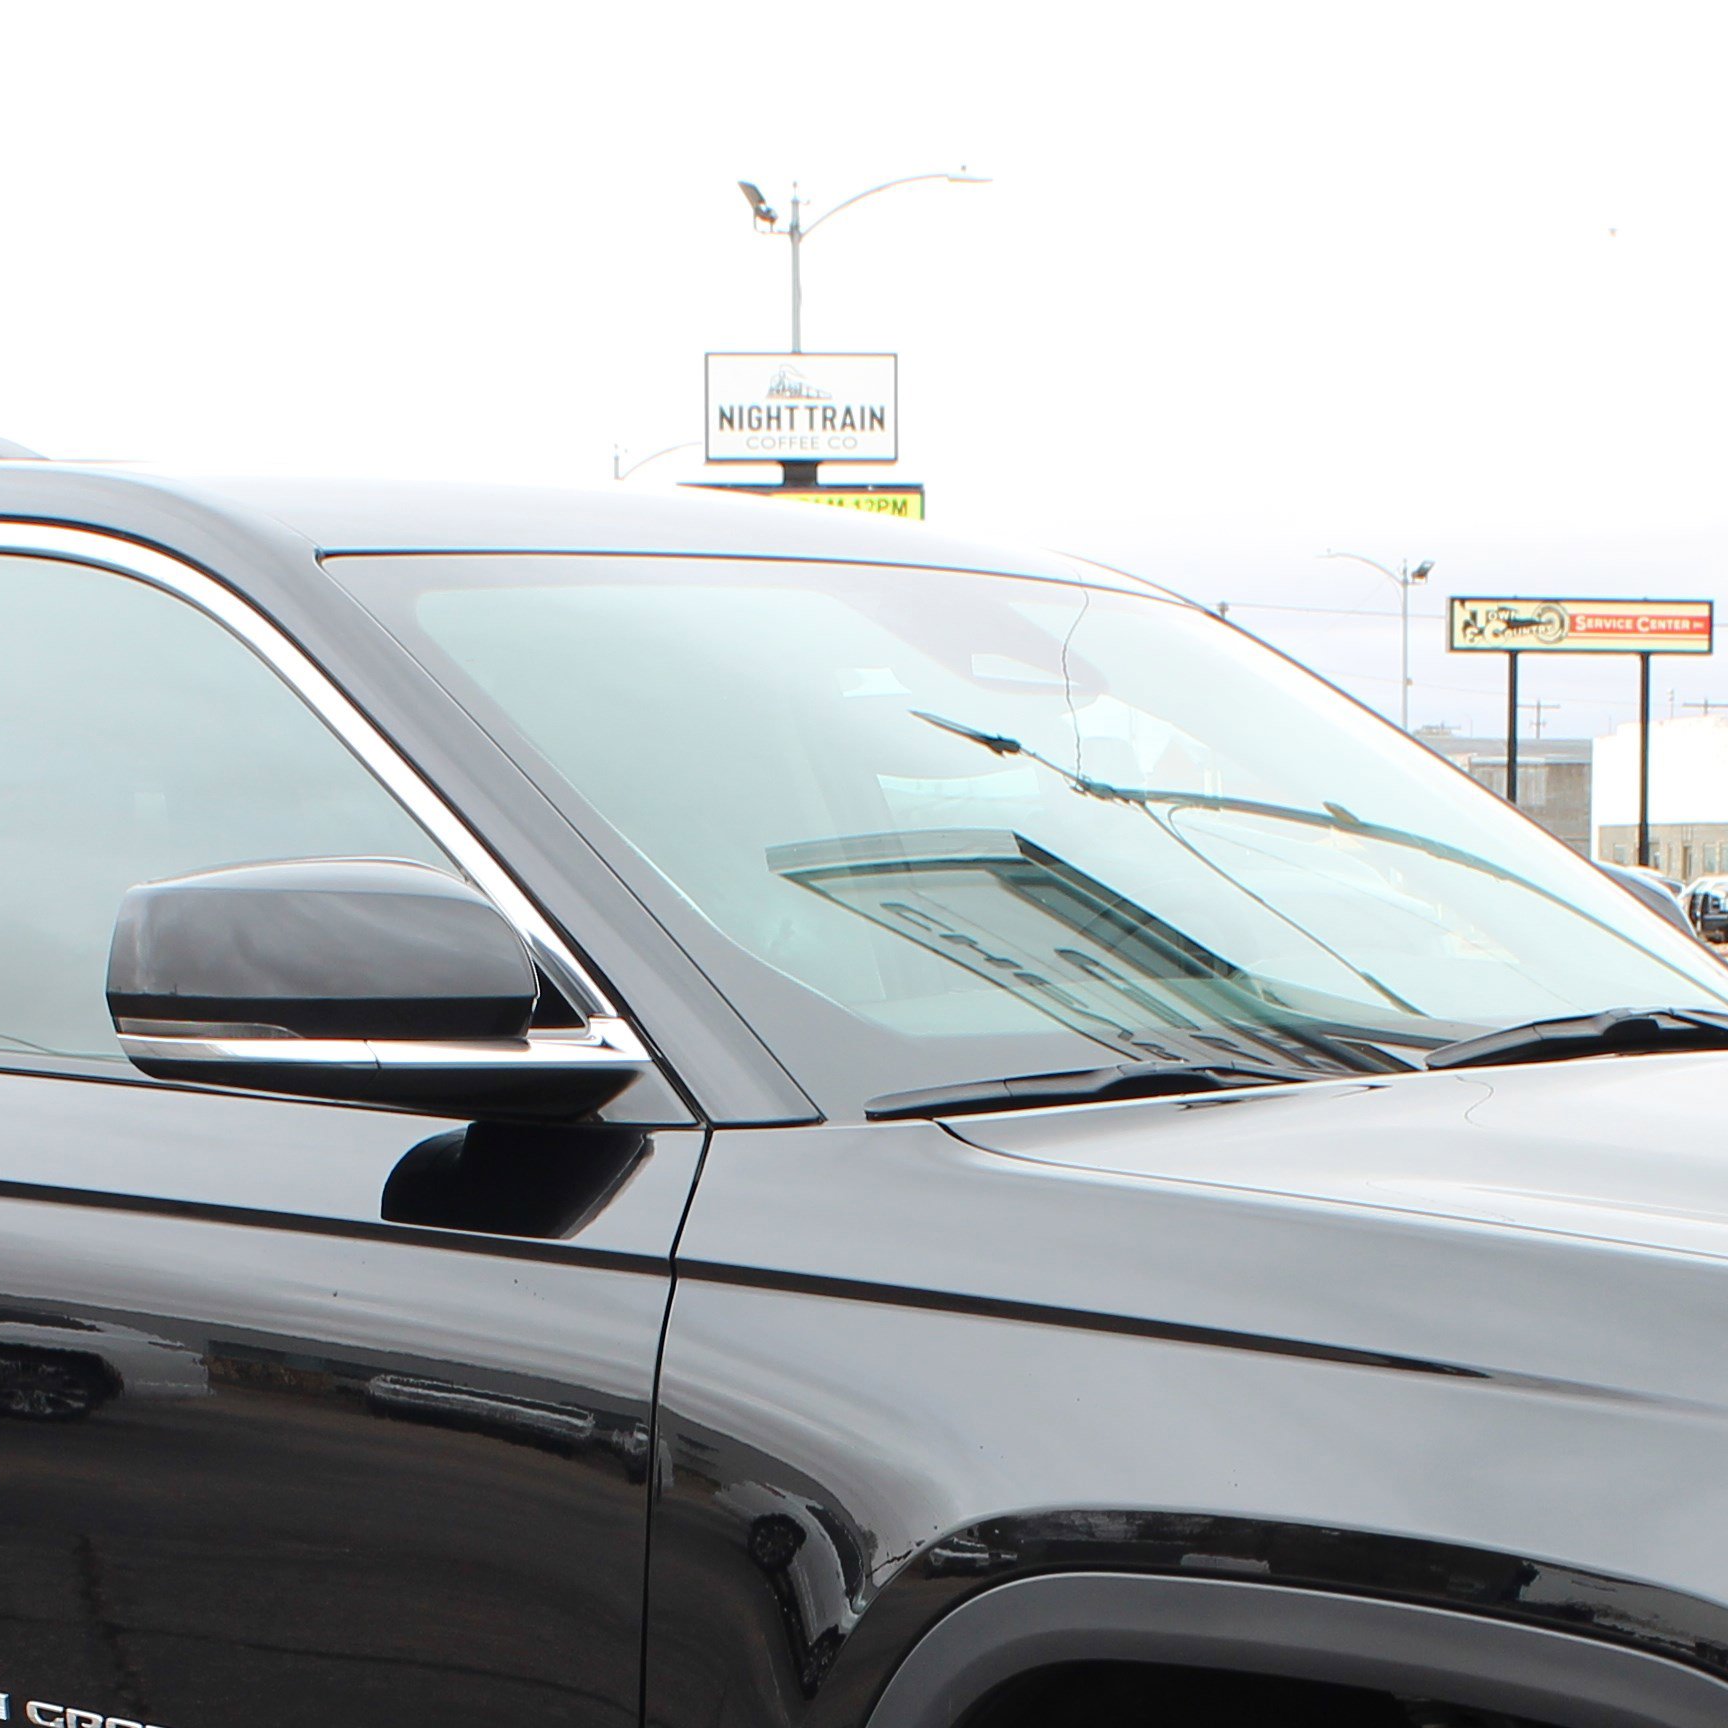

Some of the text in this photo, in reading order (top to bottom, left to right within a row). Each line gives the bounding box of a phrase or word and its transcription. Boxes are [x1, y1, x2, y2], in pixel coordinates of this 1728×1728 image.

[746, 435, 858, 451] COFFEE CO
[1574, 614, 1633, 632] SERVICE
[1637, 615, 1691, 633] CENTER
